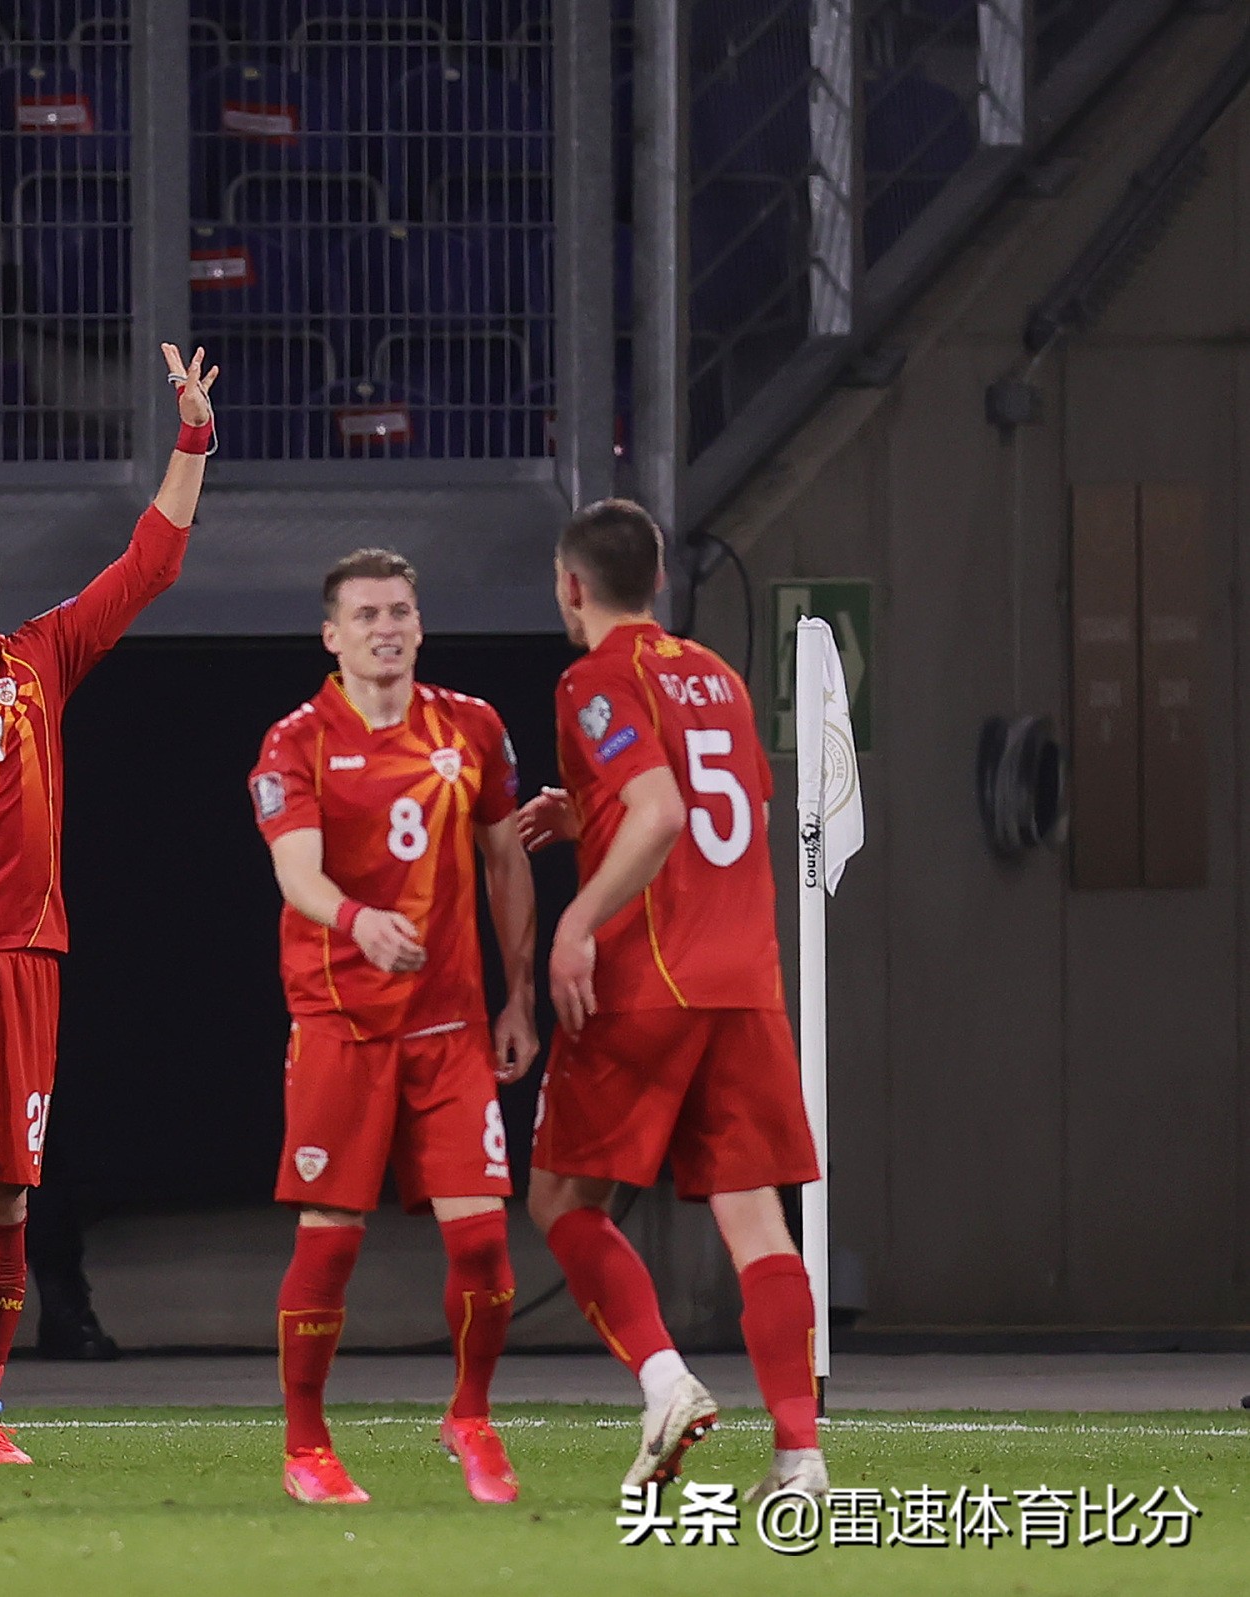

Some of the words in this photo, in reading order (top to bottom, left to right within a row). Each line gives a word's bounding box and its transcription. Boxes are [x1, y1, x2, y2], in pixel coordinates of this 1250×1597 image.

[387, 796, 429, 862] 8
[684, 728, 752, 868] 5
[482, 1099, 507, 1164] 8
